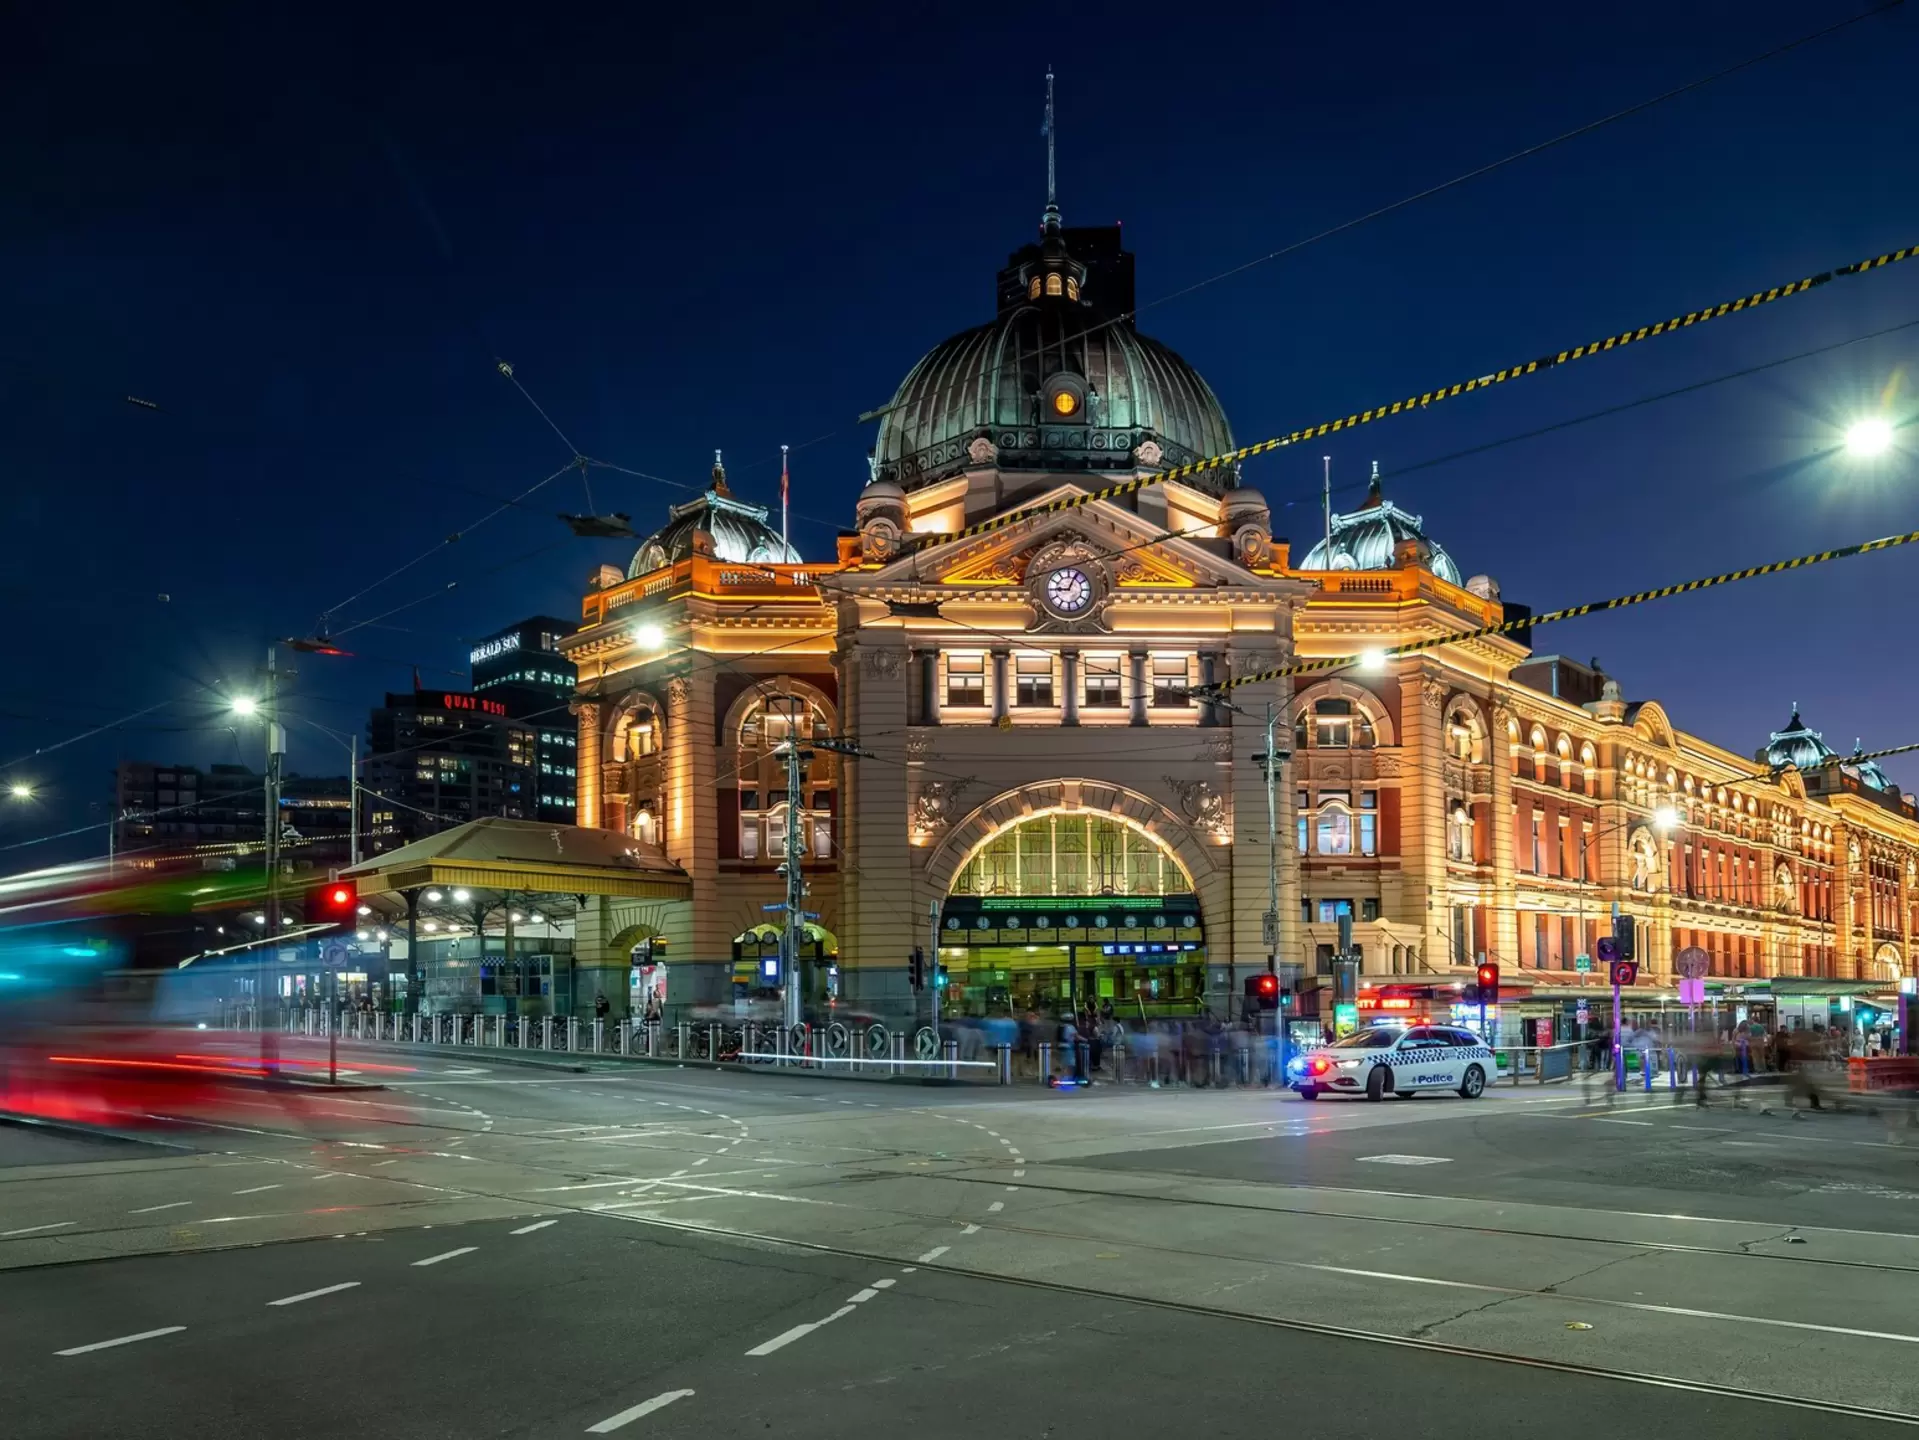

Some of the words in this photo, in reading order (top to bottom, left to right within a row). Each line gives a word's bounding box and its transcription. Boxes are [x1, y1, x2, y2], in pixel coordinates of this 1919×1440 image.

[470, 642, 502, 664] HERALD
[502, 633, 520, 651] SUN
[1418, 1074, 1453, 1084] Police
